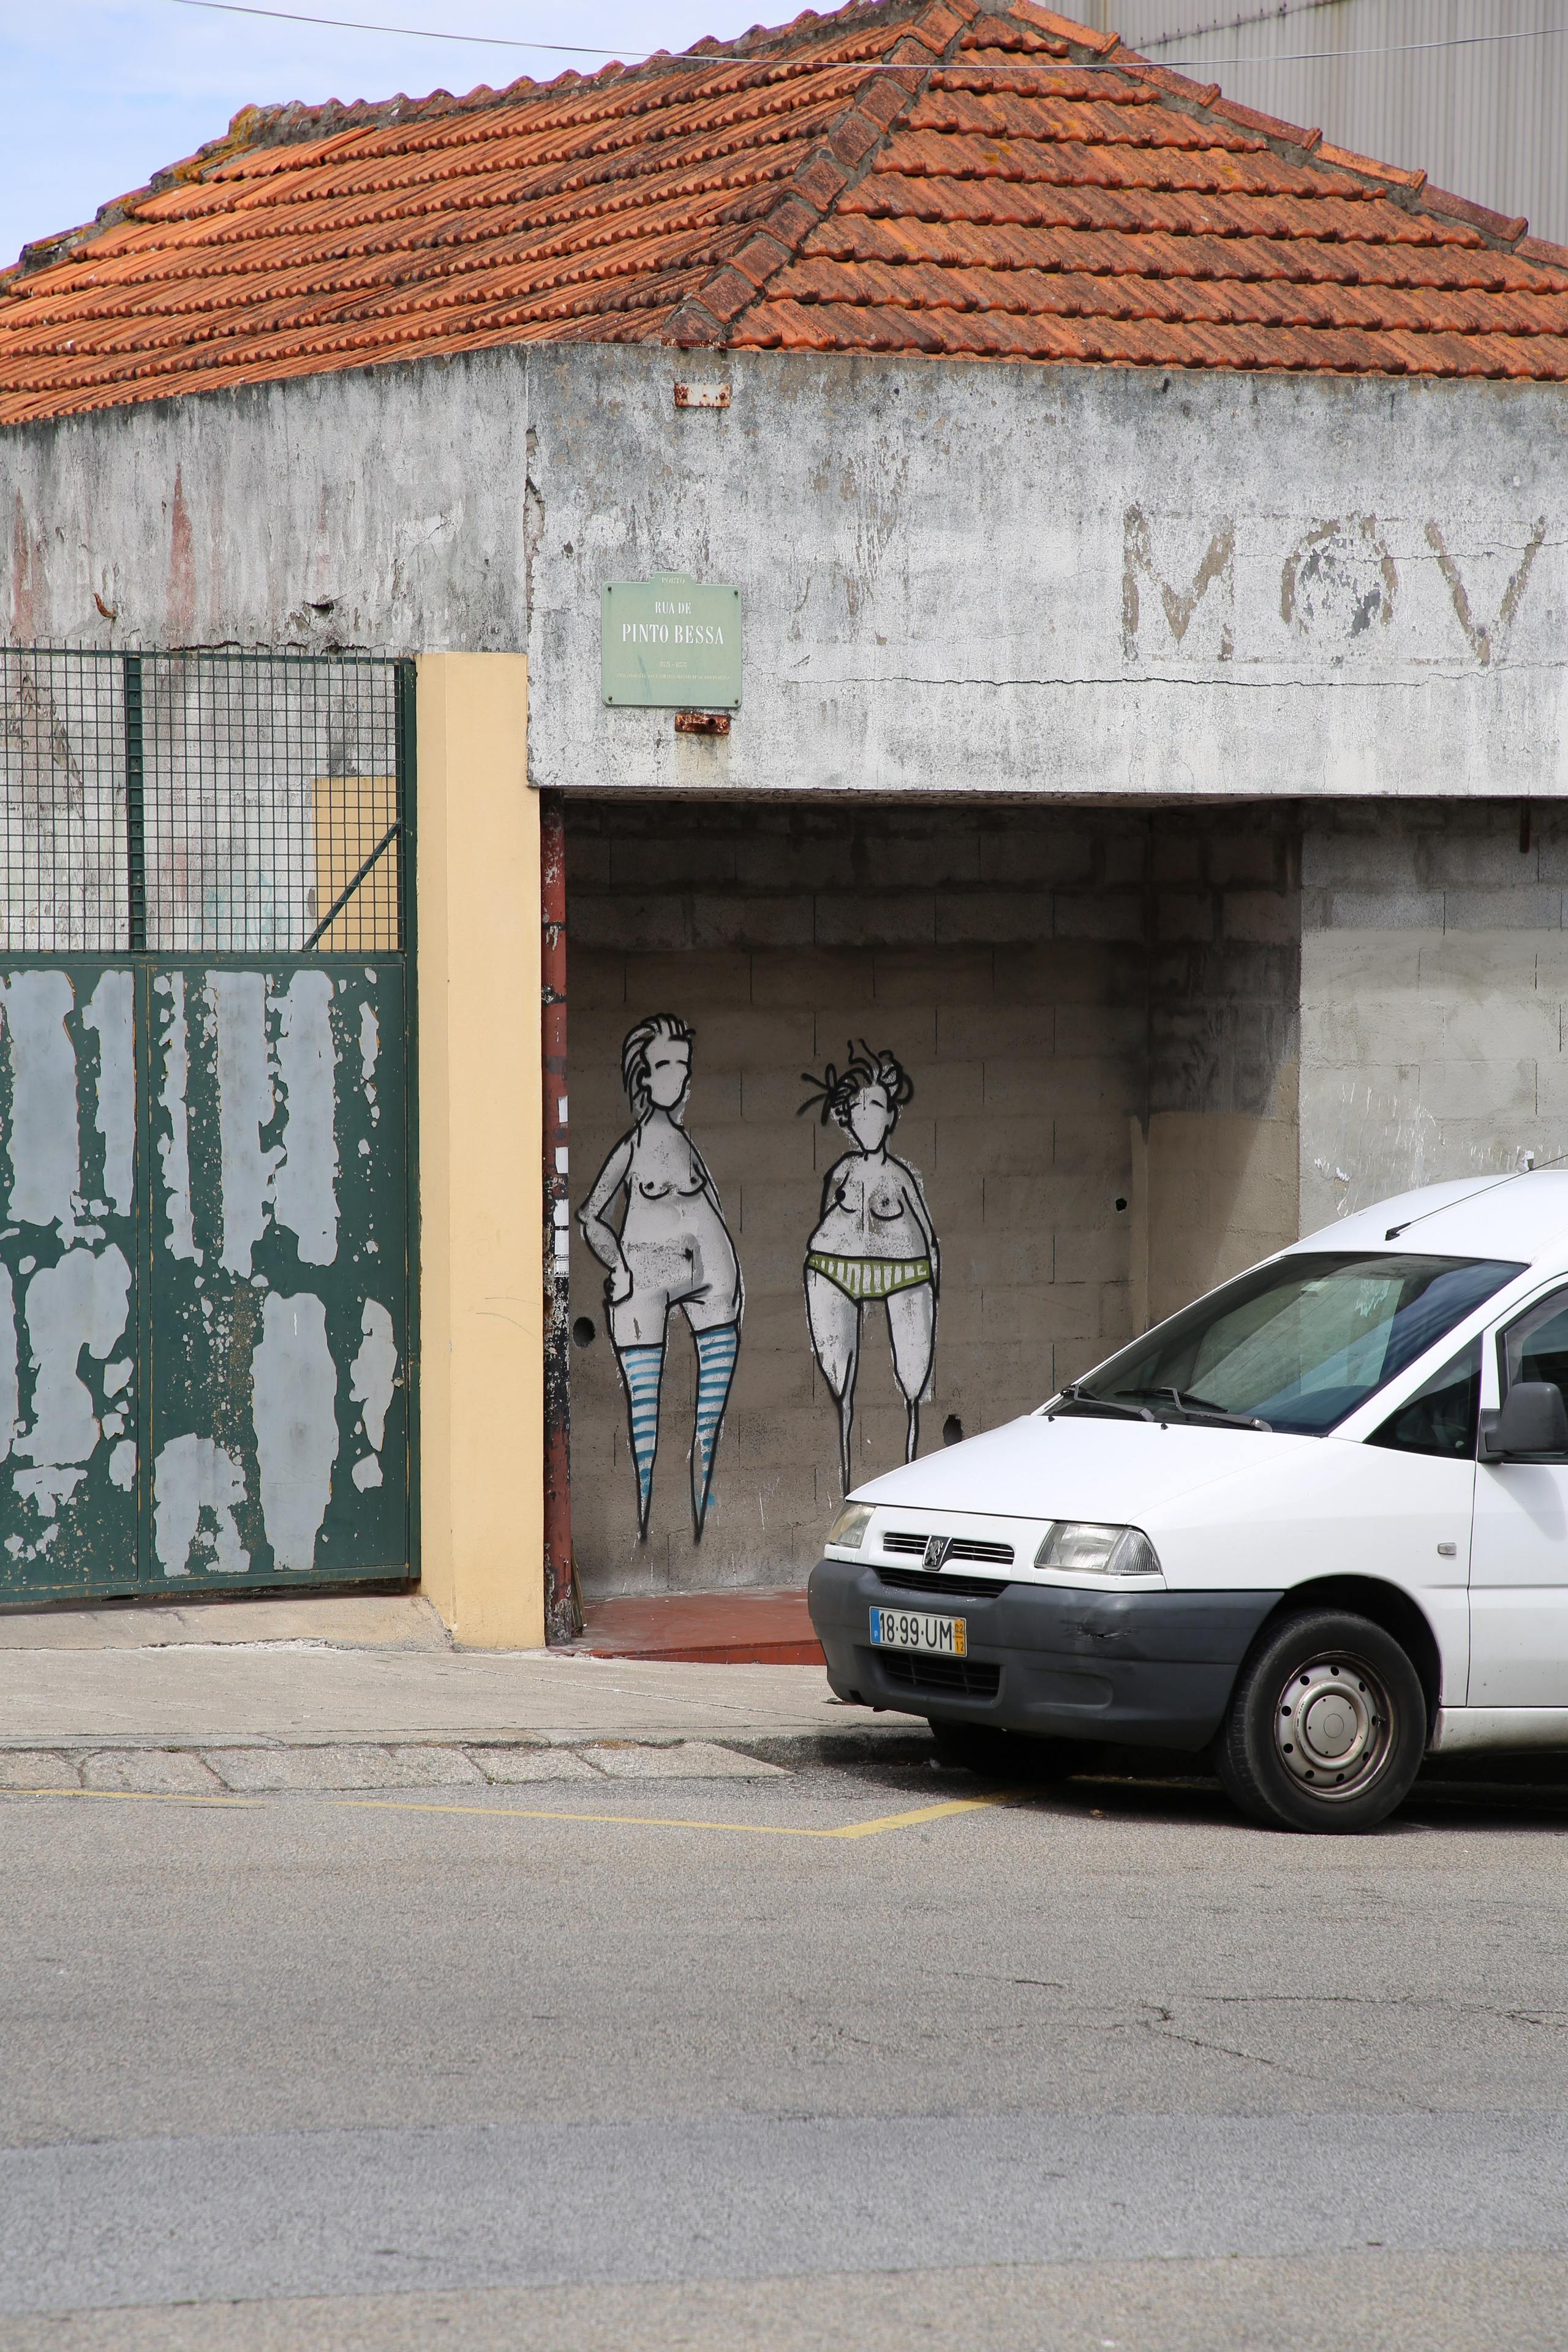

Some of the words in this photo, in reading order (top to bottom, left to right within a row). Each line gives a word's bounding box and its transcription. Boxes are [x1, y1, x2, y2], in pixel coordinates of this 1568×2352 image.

[655, 601, 675, 614] RUA
[678, 602, 692, 614] DE
[622, 624, 669, 643] PINTO
[674, 625, 724, 644] BESSA
[956, 1642, 964, 1651] 12
